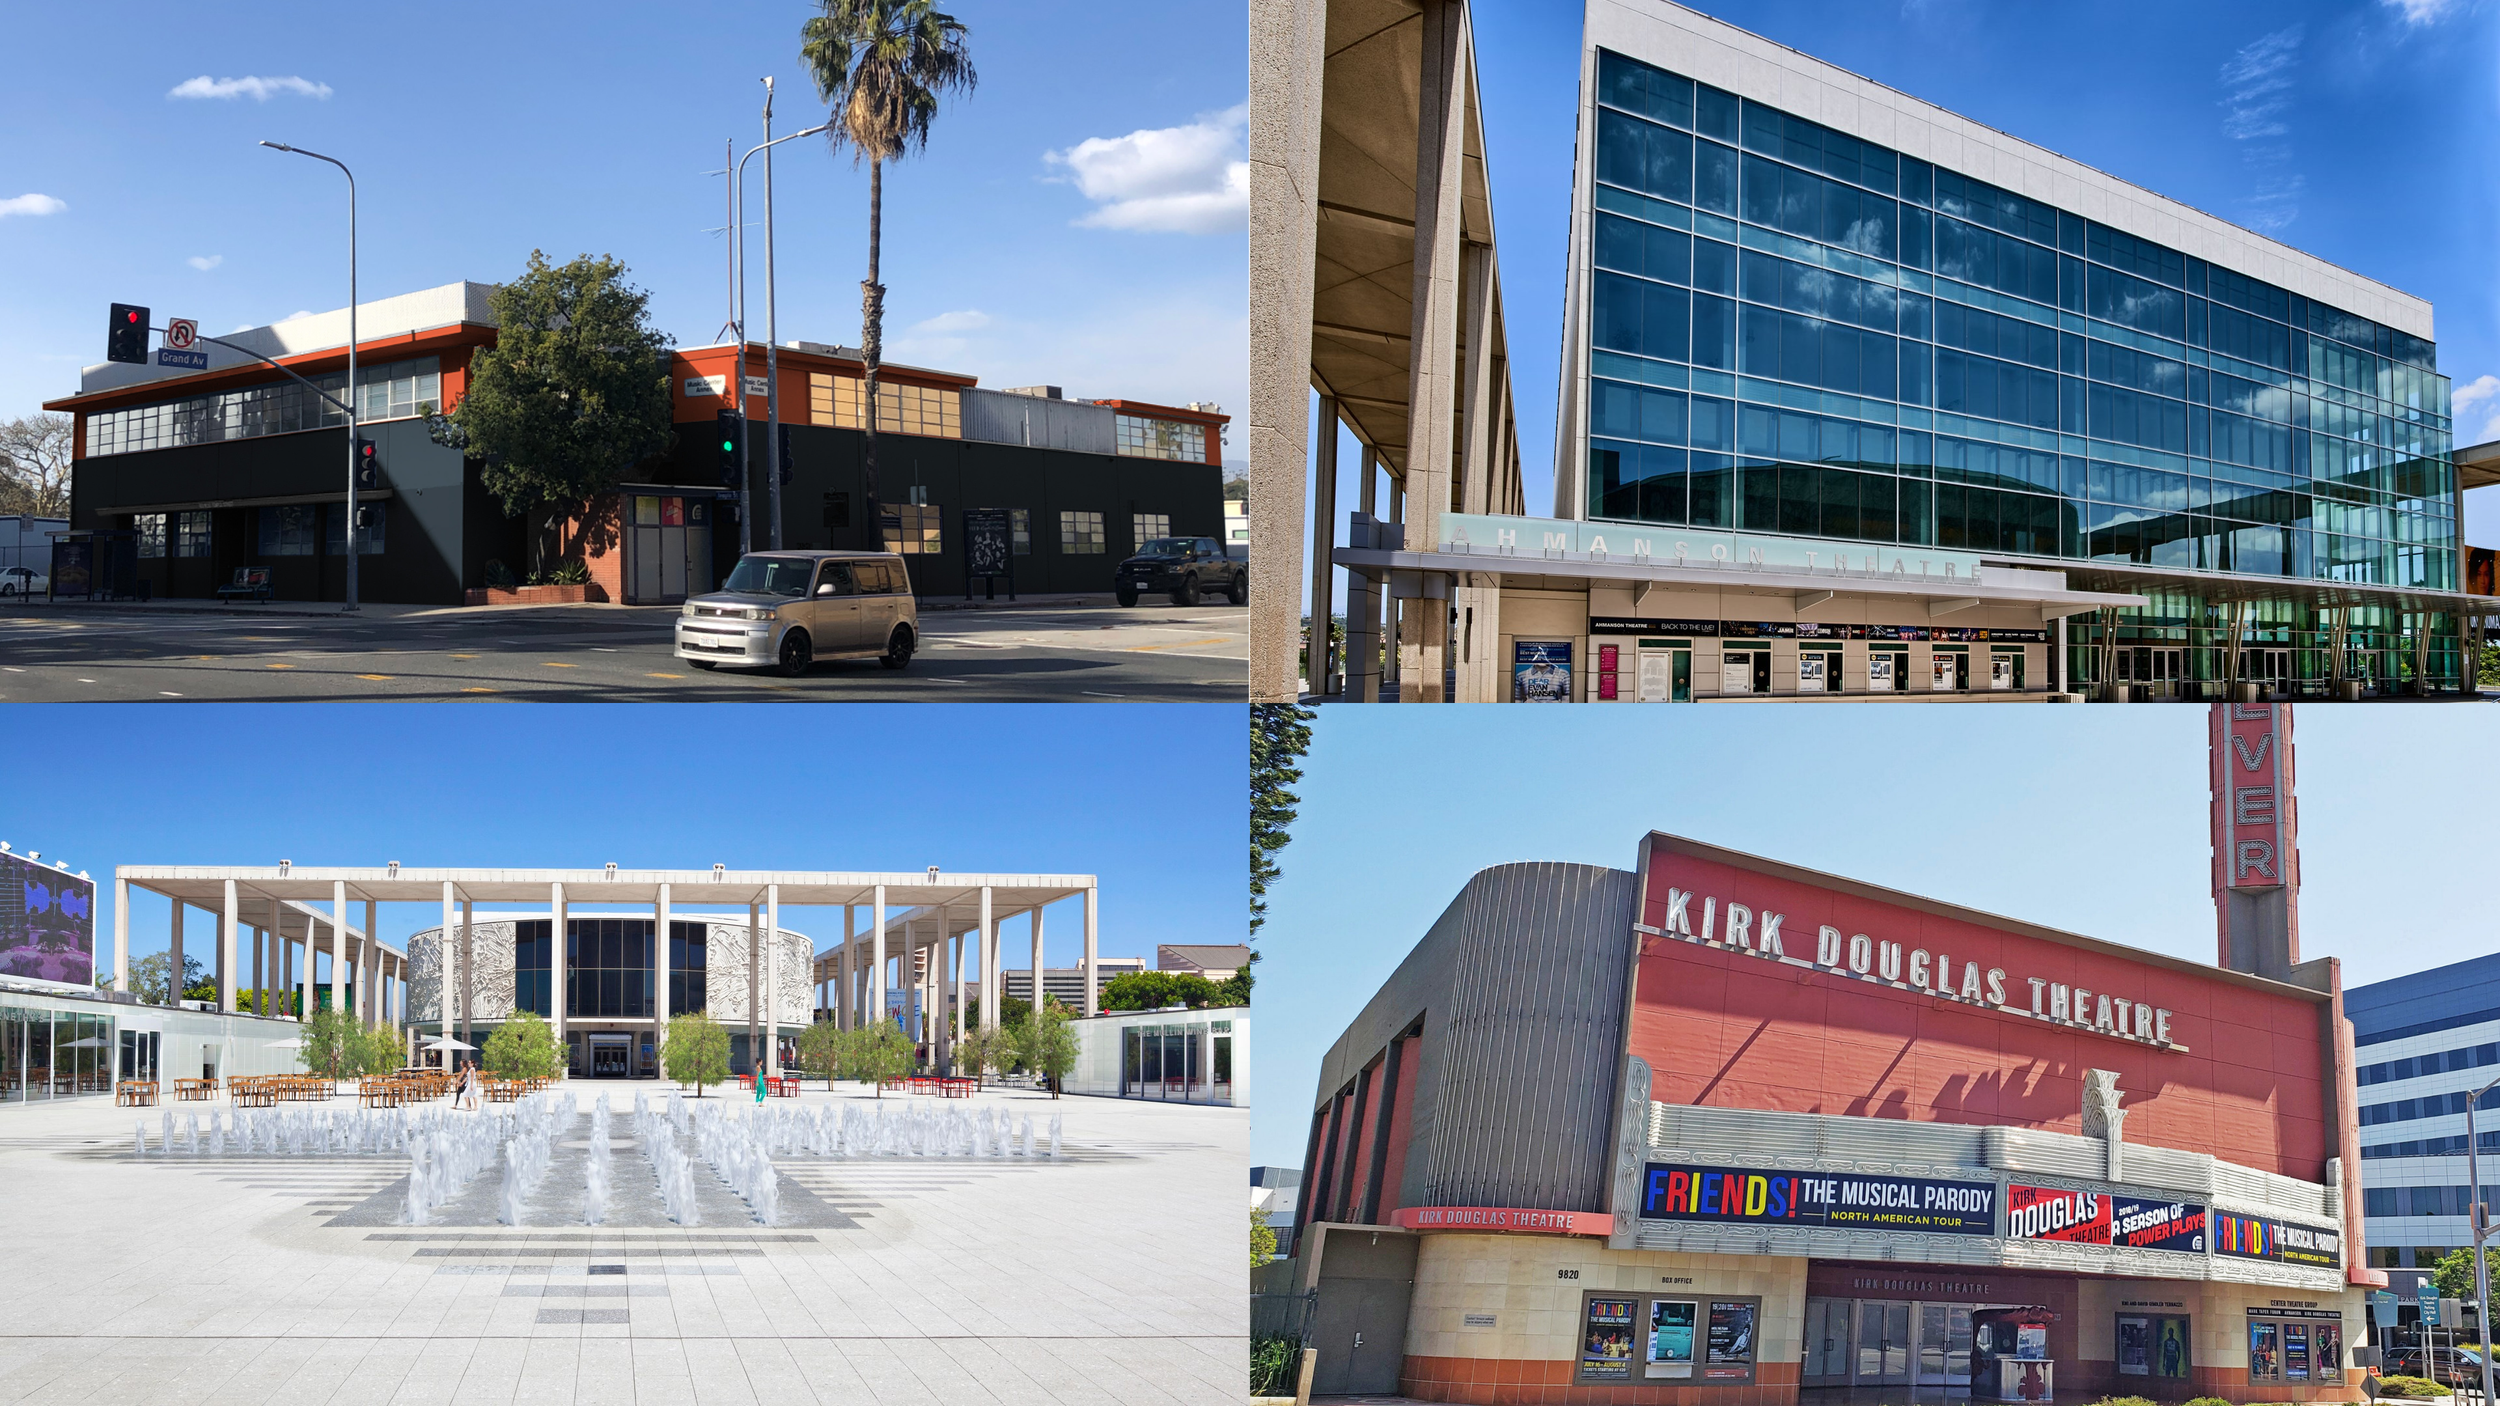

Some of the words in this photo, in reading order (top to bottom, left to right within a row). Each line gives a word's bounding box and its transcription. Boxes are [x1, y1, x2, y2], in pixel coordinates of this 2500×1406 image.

[162, 352, 189, 364] Grand
[192, 356, 204, 365] Av
[1451, 525, 1765, 563] AHMANSON
[1805, 550, 1981, 578] THEATRE
[1665, 886, 1786, 955] KIRK
[1817, 924, 2007, 1006] DOUGLAS
[2027, 976, 2174, 1045] THEATRE
[1153, 1029, 1183, 1037] MULLIN
[1646, 1170, 1798, 1218] FRIENDS!
[1803, 1178, 1836, 1204] THE
[1842, 1180, 1920, 1208] MUSICAL
[1924, 1186, 1992, 1214] PARODY
[2013, 1188, 2037, 1208] KIRK
[1418, 1211, 1442, 1224] KIRK
[1446, 1211, 1506, 1225] DOUGLAS
[1513, 1212, 1573, 1229] THEATRE
[1831, 1211, 1870, 1222] NORTH
[1873, 1212, 1930, 1226] AMERICAN
[1933, 1215, 1962, 1227] TOUR
[2011, 1192, 2098, 1238] DOUGLAS
[2113, 1220, 2121, 1237] A
[2123, 1211, 2168, 1234] SEASON
[2170, 1203, 2185, 1219] OF
[2069, 1222, 2110, 1243] THEATRE
[2129, 1226, 2170, 1247] POWER
[2172, 1212, 2205, 1234] PLAYS
[2215, 1215, 2273, 1256] FRIENDS!
[2273, 1225, 2286, 1245] THE
[2287, 1227, 2315, 1249] MUSICAL
[2315, 1232, 2338, 1253] PARODY
[2285, 1251, 2298, 1259] NORTH
[2299, 1253, 2319, 1262] AMERICAN
[2319, 1255, 2330, 1263] TOUR
[1558, 1270, 1579, 1279] 9820
[1674, 1277, 1692, 1285] OFFICE
[1854, 1278, 1879, 1290] KIRK
[1884, 1280, 1933, 1292] DOUGLAS
[1940, 1283, 1990, 1294] THEATRE
[1592, 1304, 1632, 1316] FRIENDS!
